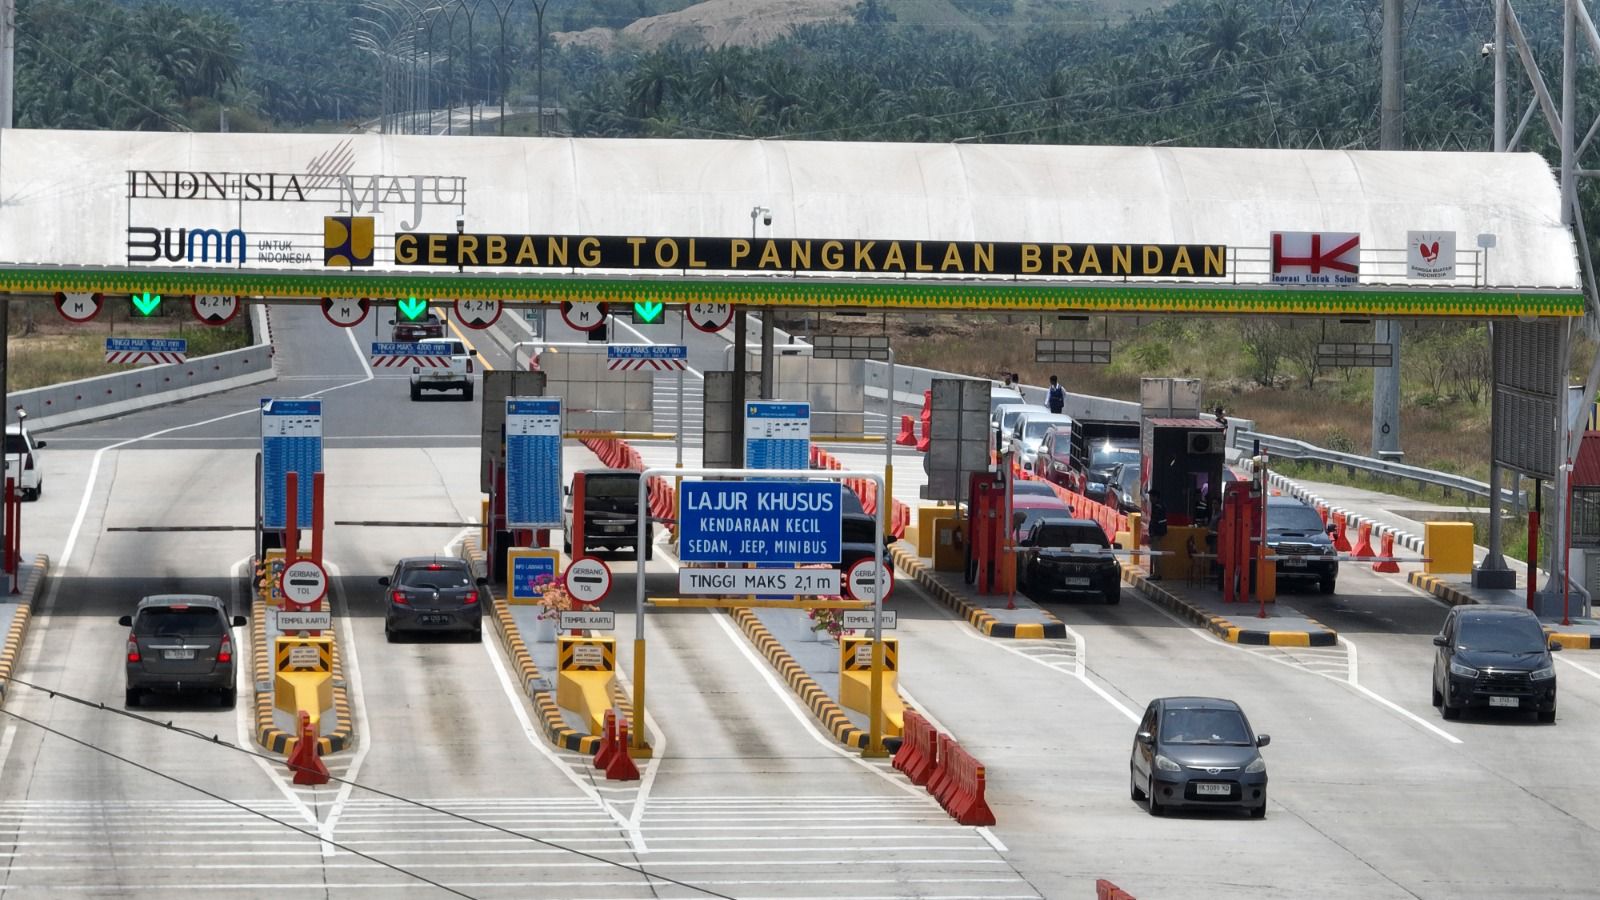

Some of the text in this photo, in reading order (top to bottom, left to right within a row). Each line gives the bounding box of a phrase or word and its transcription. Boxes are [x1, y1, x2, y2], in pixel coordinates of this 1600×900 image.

[131, 170, 461, 232] INDONESIA MAJU
[258, 240, 293, 251] UNTUK
[258, 252, 312, 264] INDONESIA
[395, 234, 1225, 276] GERBANG TOL PANGKALAN BRANDAN
[1273, 233, 1360, 275] HK
[1271, 274, 1359, 284] Inovasi Untuk Solusi
[200, 296, 232, 307] 4,2 M
[464, 301, 495, 312] 4,2 M
[74, 302, 84, 313] M
[340, 307, 350, 318] M
[694, 303, 727, 314] 4,2 M
[579, 311, 589, 322] M
[687, 491, 833, 512] LAJUR KHUSUS
[700, 518, 821, 533] KENDARAAN KECIL
[688, 539, 732, 556] SEDAN,
[739, 540, 769, 556] JEEP,
[289, 570, 320, 578] GERBANG
[572, 567, 603, 576] GERBANG
[690, 574, 831, 592] TINGGI MAKS 2,1 m
[296, 587, 311, 595] TOL
[281, 616, 328, 625] TEMPEL KARTU
[564, 616, 612, 624] TEMPEL KARTU
